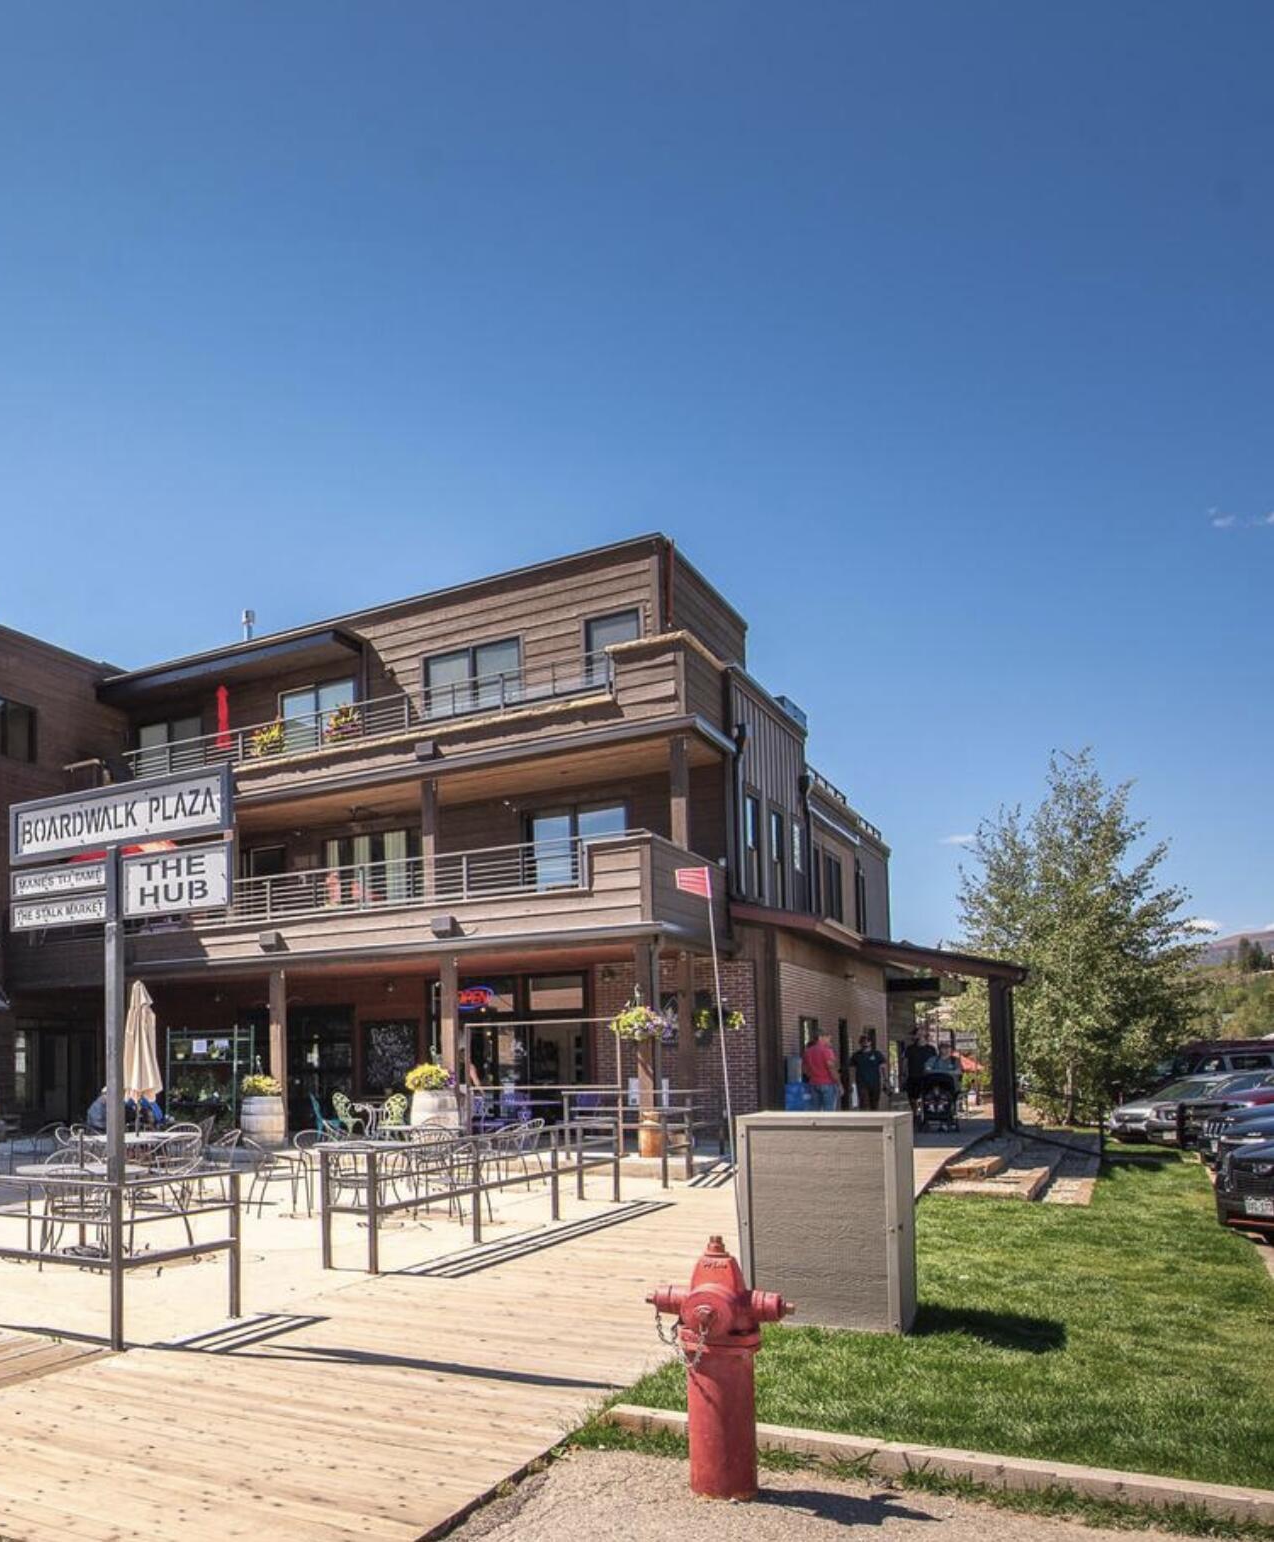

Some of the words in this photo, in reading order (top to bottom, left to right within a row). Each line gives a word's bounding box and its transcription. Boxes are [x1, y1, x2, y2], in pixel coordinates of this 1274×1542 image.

[22, 800, 138, 845] BOARDWALK
[148, 786, 216, 824] PLAZA
[139, 854, 206, 882] THE
[139, 880, 209, 906] HUB
[17, 909, 34, 921] THE
[35, 907, 64, 919] STALK
[66, 902, 103, 917] MARKET
